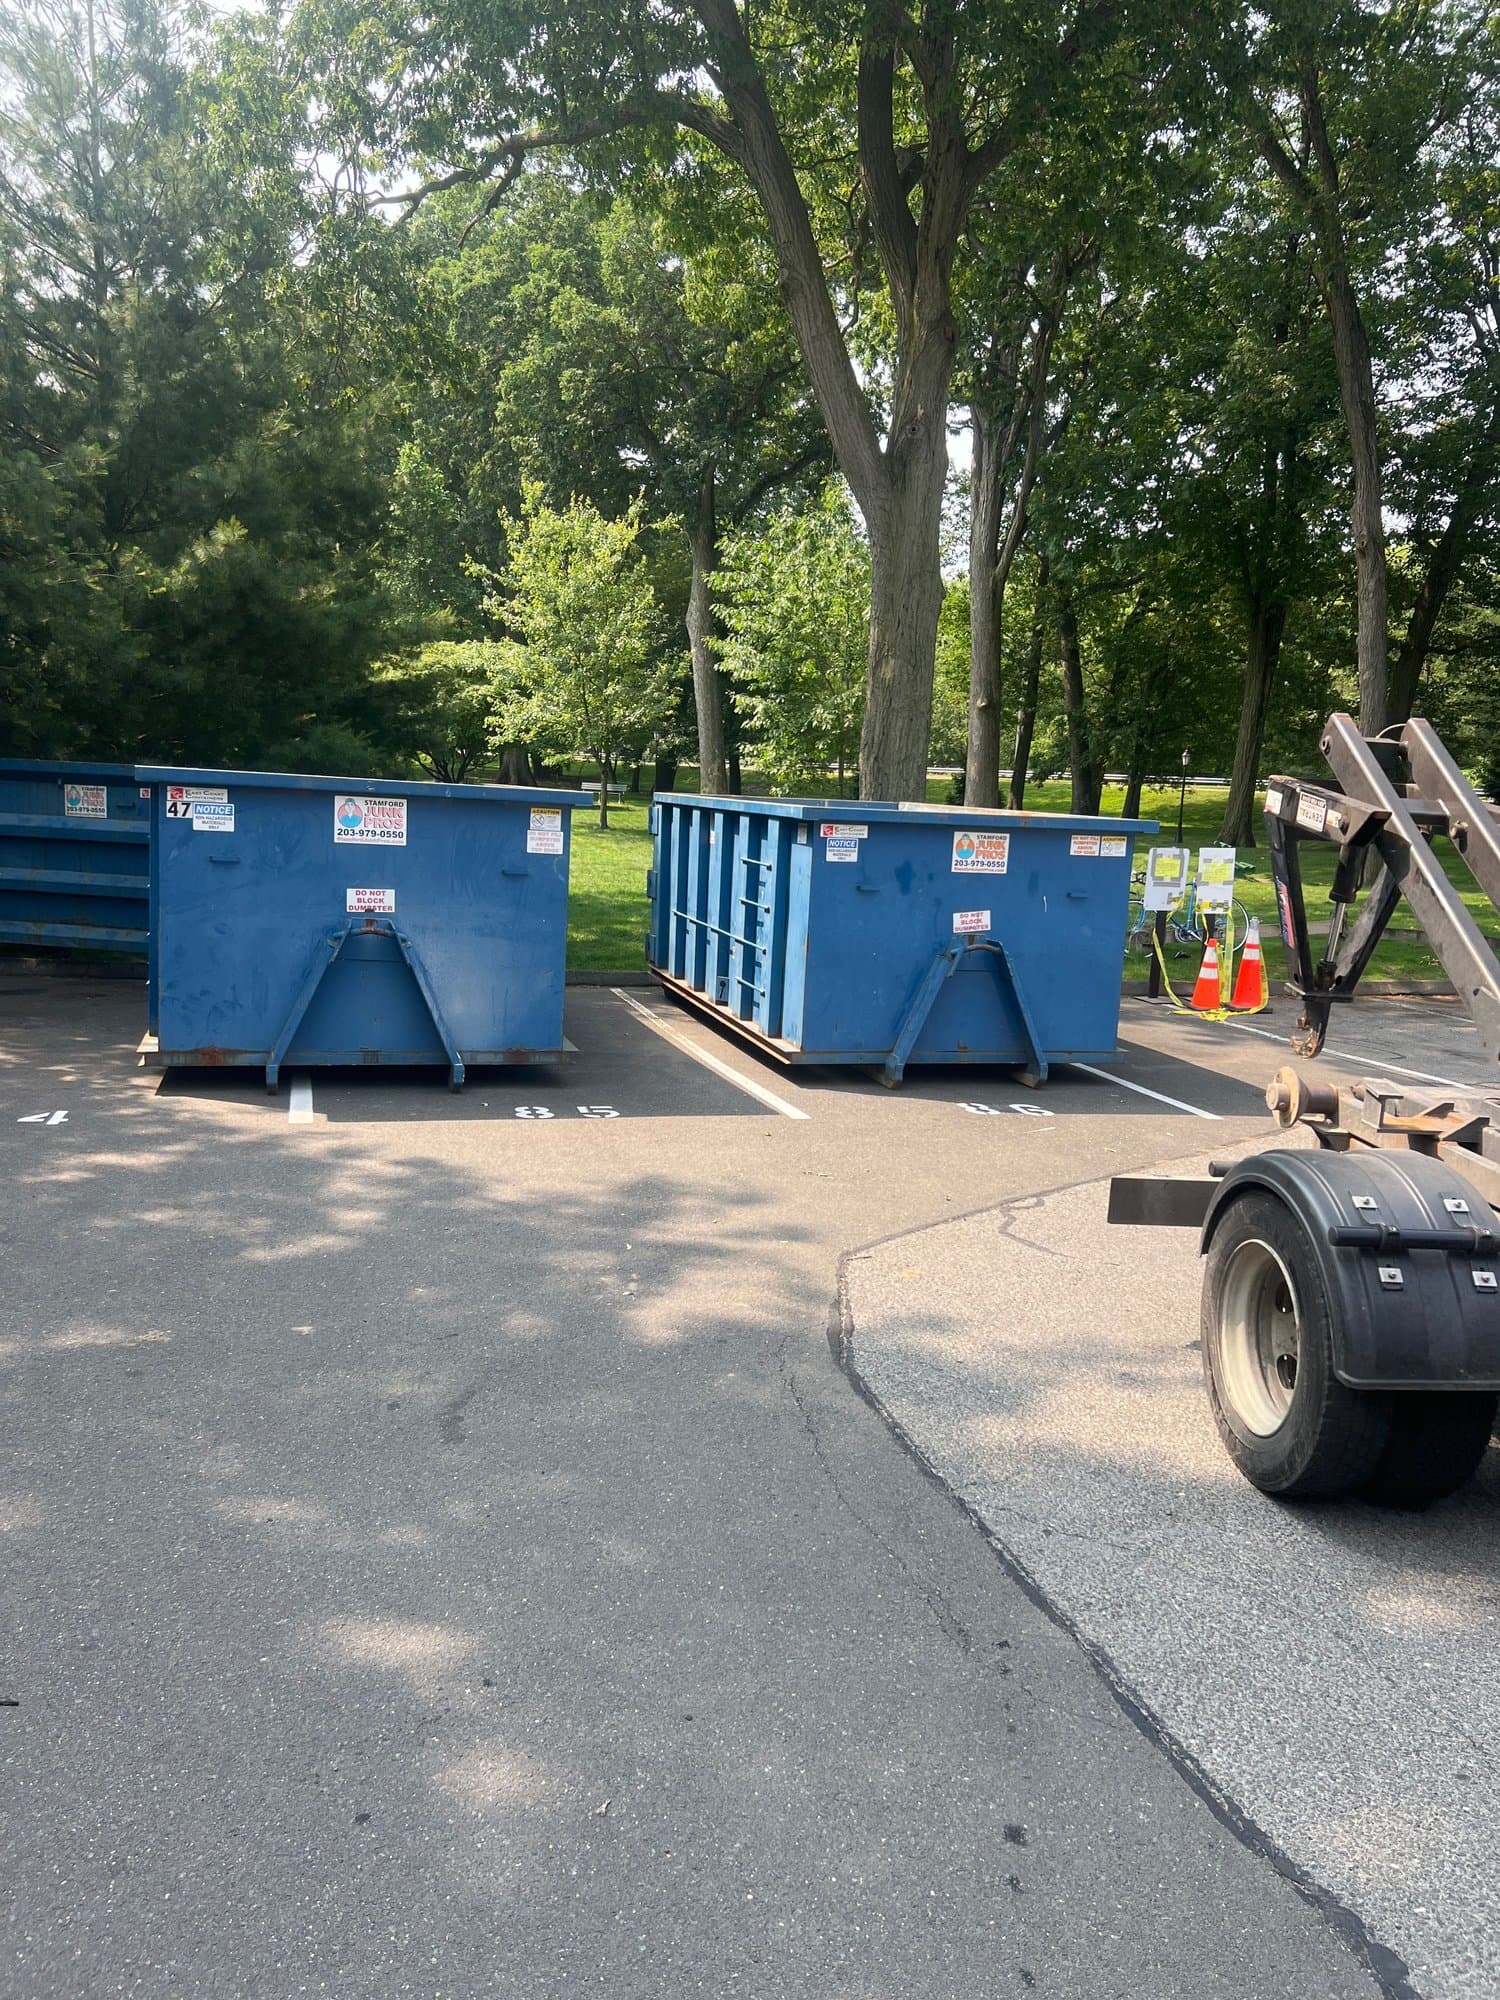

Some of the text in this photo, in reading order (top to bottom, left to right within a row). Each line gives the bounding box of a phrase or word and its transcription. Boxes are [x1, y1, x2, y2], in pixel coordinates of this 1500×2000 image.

[167, 802, 192, 817] 47
[195, 805, 232, 815] NOTICE
[364, 806, 404, 818] JUNK
[363, 816, 404, 829] PROS
[336, 828, 404, 839] 203-979-0550
[829, 840, 857, 848] NOTICE
[975, 840, 1006, 850] JUNK
[975, 849, 1006, 860] PROS
[954, 859, 1006, 868] 203-979-0550
[954, 924, 989, 932] DUMPSTER
